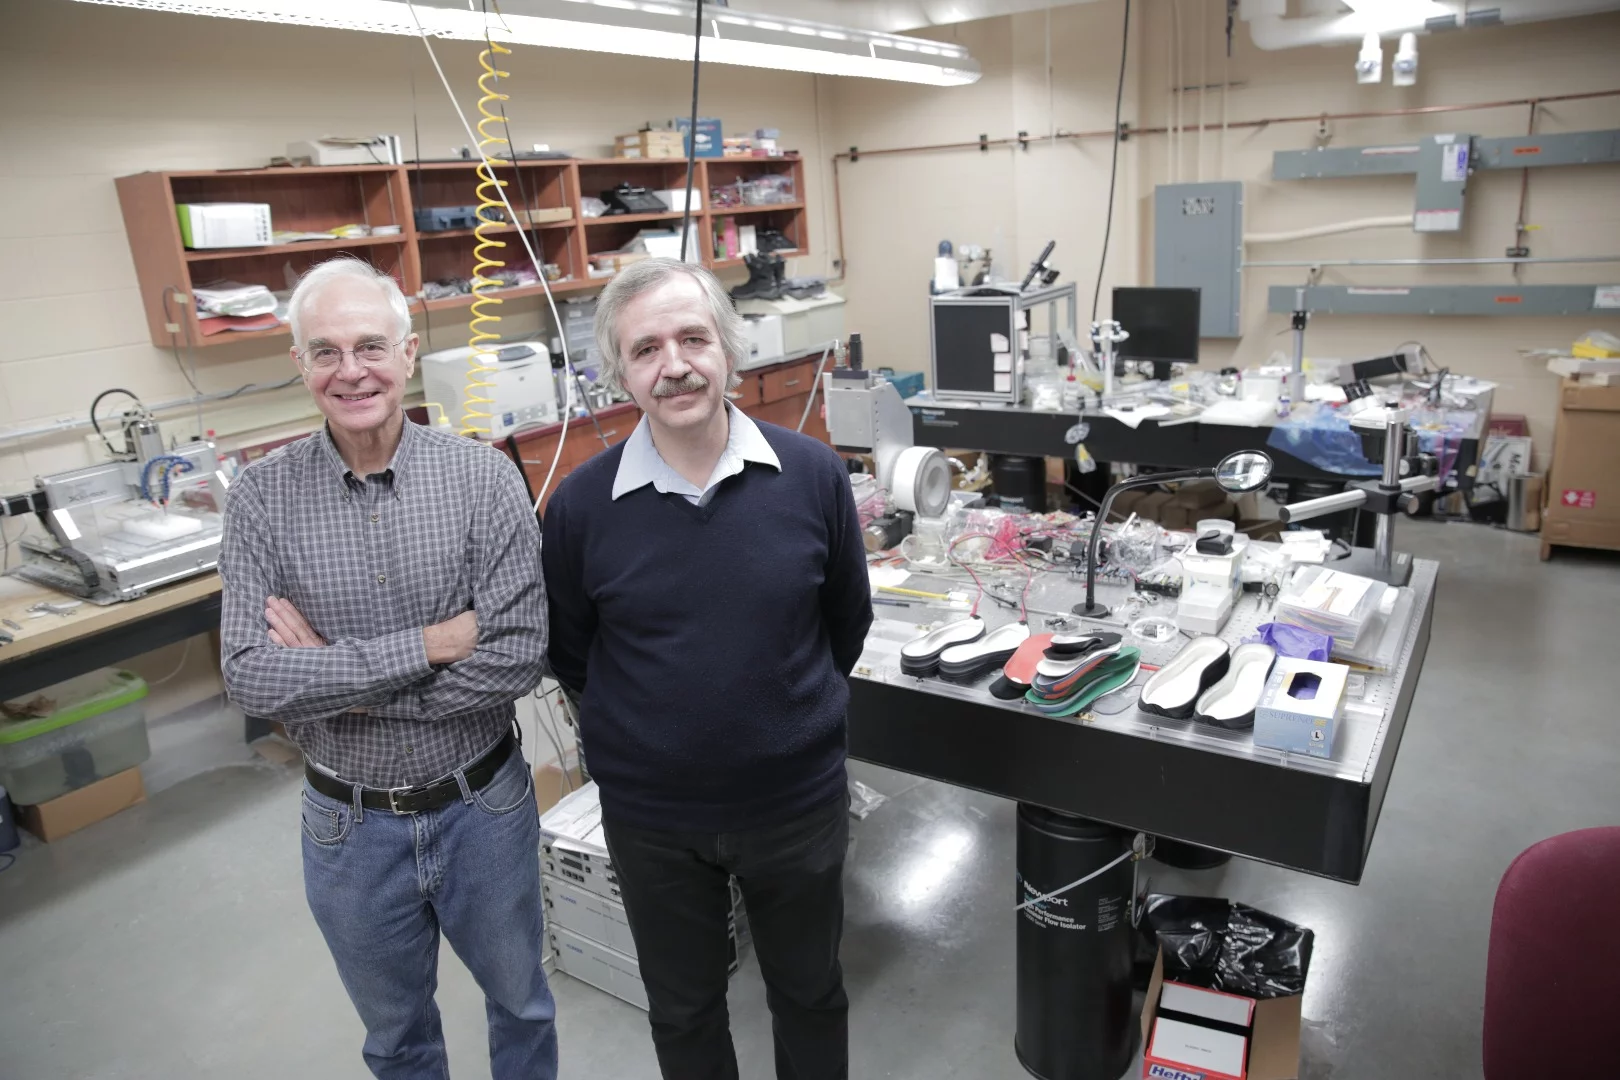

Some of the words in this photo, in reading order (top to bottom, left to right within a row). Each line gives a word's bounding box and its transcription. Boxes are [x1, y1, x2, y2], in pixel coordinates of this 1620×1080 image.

[1315, 731, 1320, 739] L
[1035, 906, 1075, 924] Performance
[1044, 916, 1059, 927] Flow
[1060, 921, 1086, 930] Isolator
